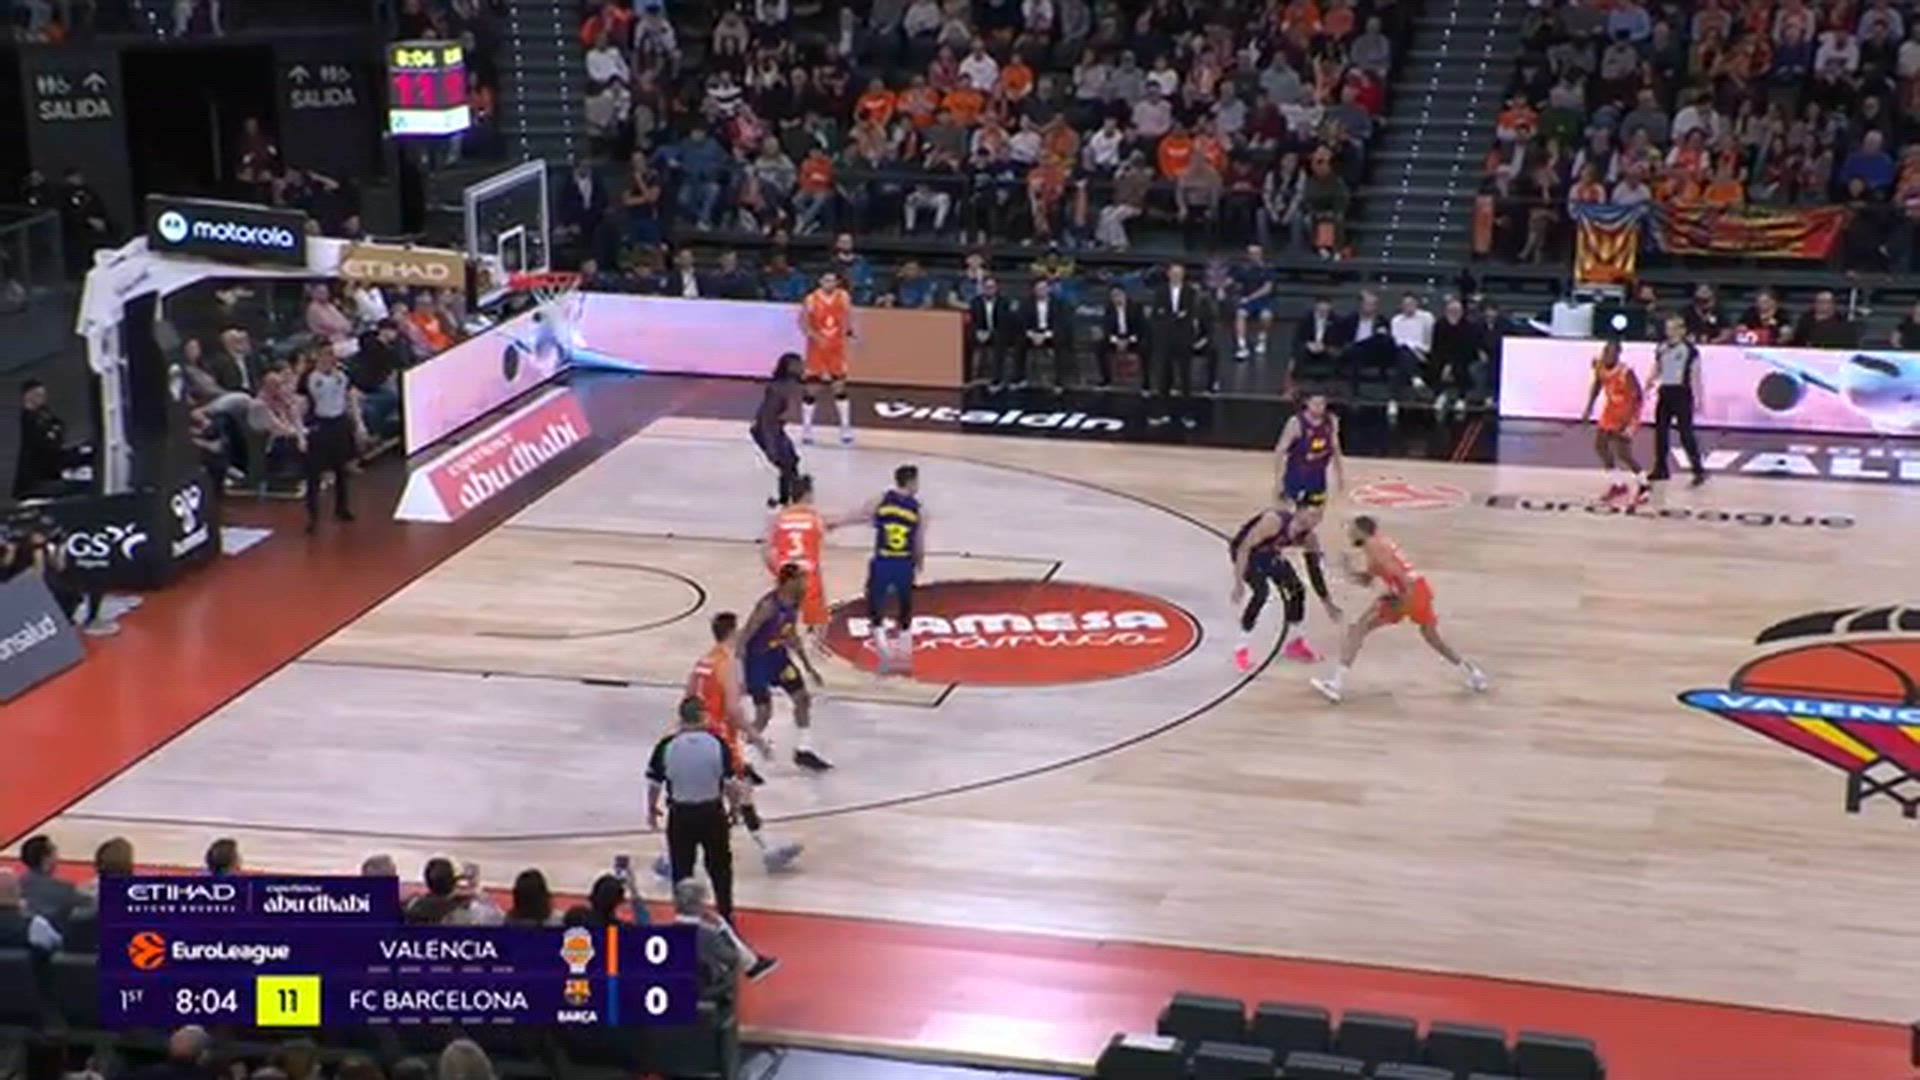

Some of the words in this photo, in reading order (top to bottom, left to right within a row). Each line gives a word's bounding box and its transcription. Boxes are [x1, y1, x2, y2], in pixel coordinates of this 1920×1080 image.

[38, 99, 114, 121] SALIDA
[290, 88, 357, 110] SALIDA
[193, 221, 294, 247] motorola
[342, 259, 451, 282] ETIHAD
[459, 470, 513, 509] abu
[508, 415, 580, 478] dhabi
[787, 531, 806, 557] 3
